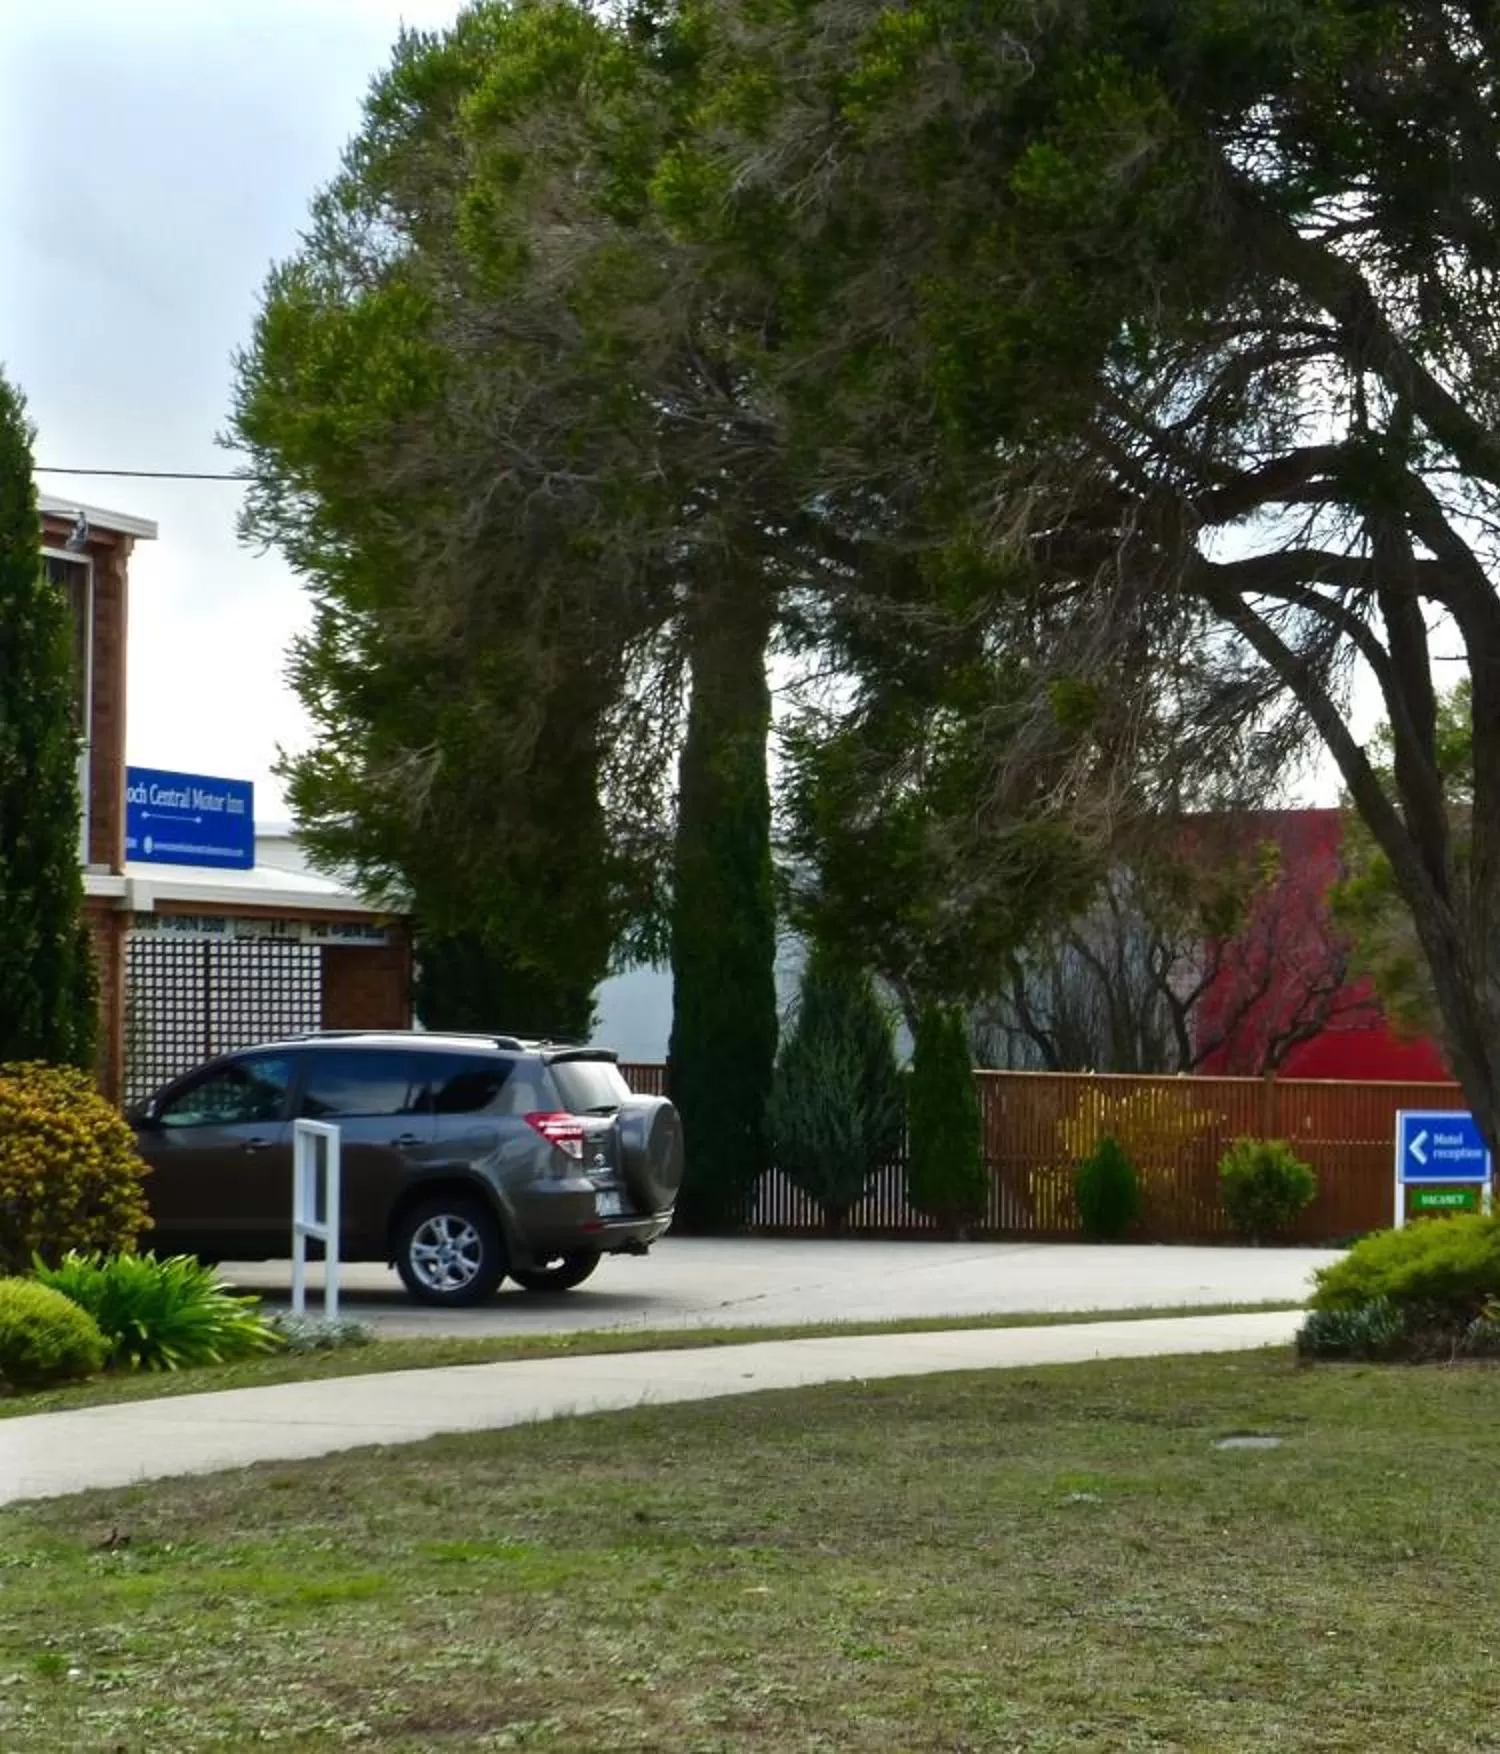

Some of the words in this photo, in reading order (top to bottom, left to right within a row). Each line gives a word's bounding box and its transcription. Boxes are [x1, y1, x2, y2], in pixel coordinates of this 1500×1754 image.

[149, 783, 191, 809] Central
[192, 787, 225, 813] Motor
[226, 791, 245, 815] Inn
[1433, 1131, 1464, 1146] Motel
[1433, 1147, 1482, 1161] reception
[1421, 1194, 1465, 1205] VACANCY
